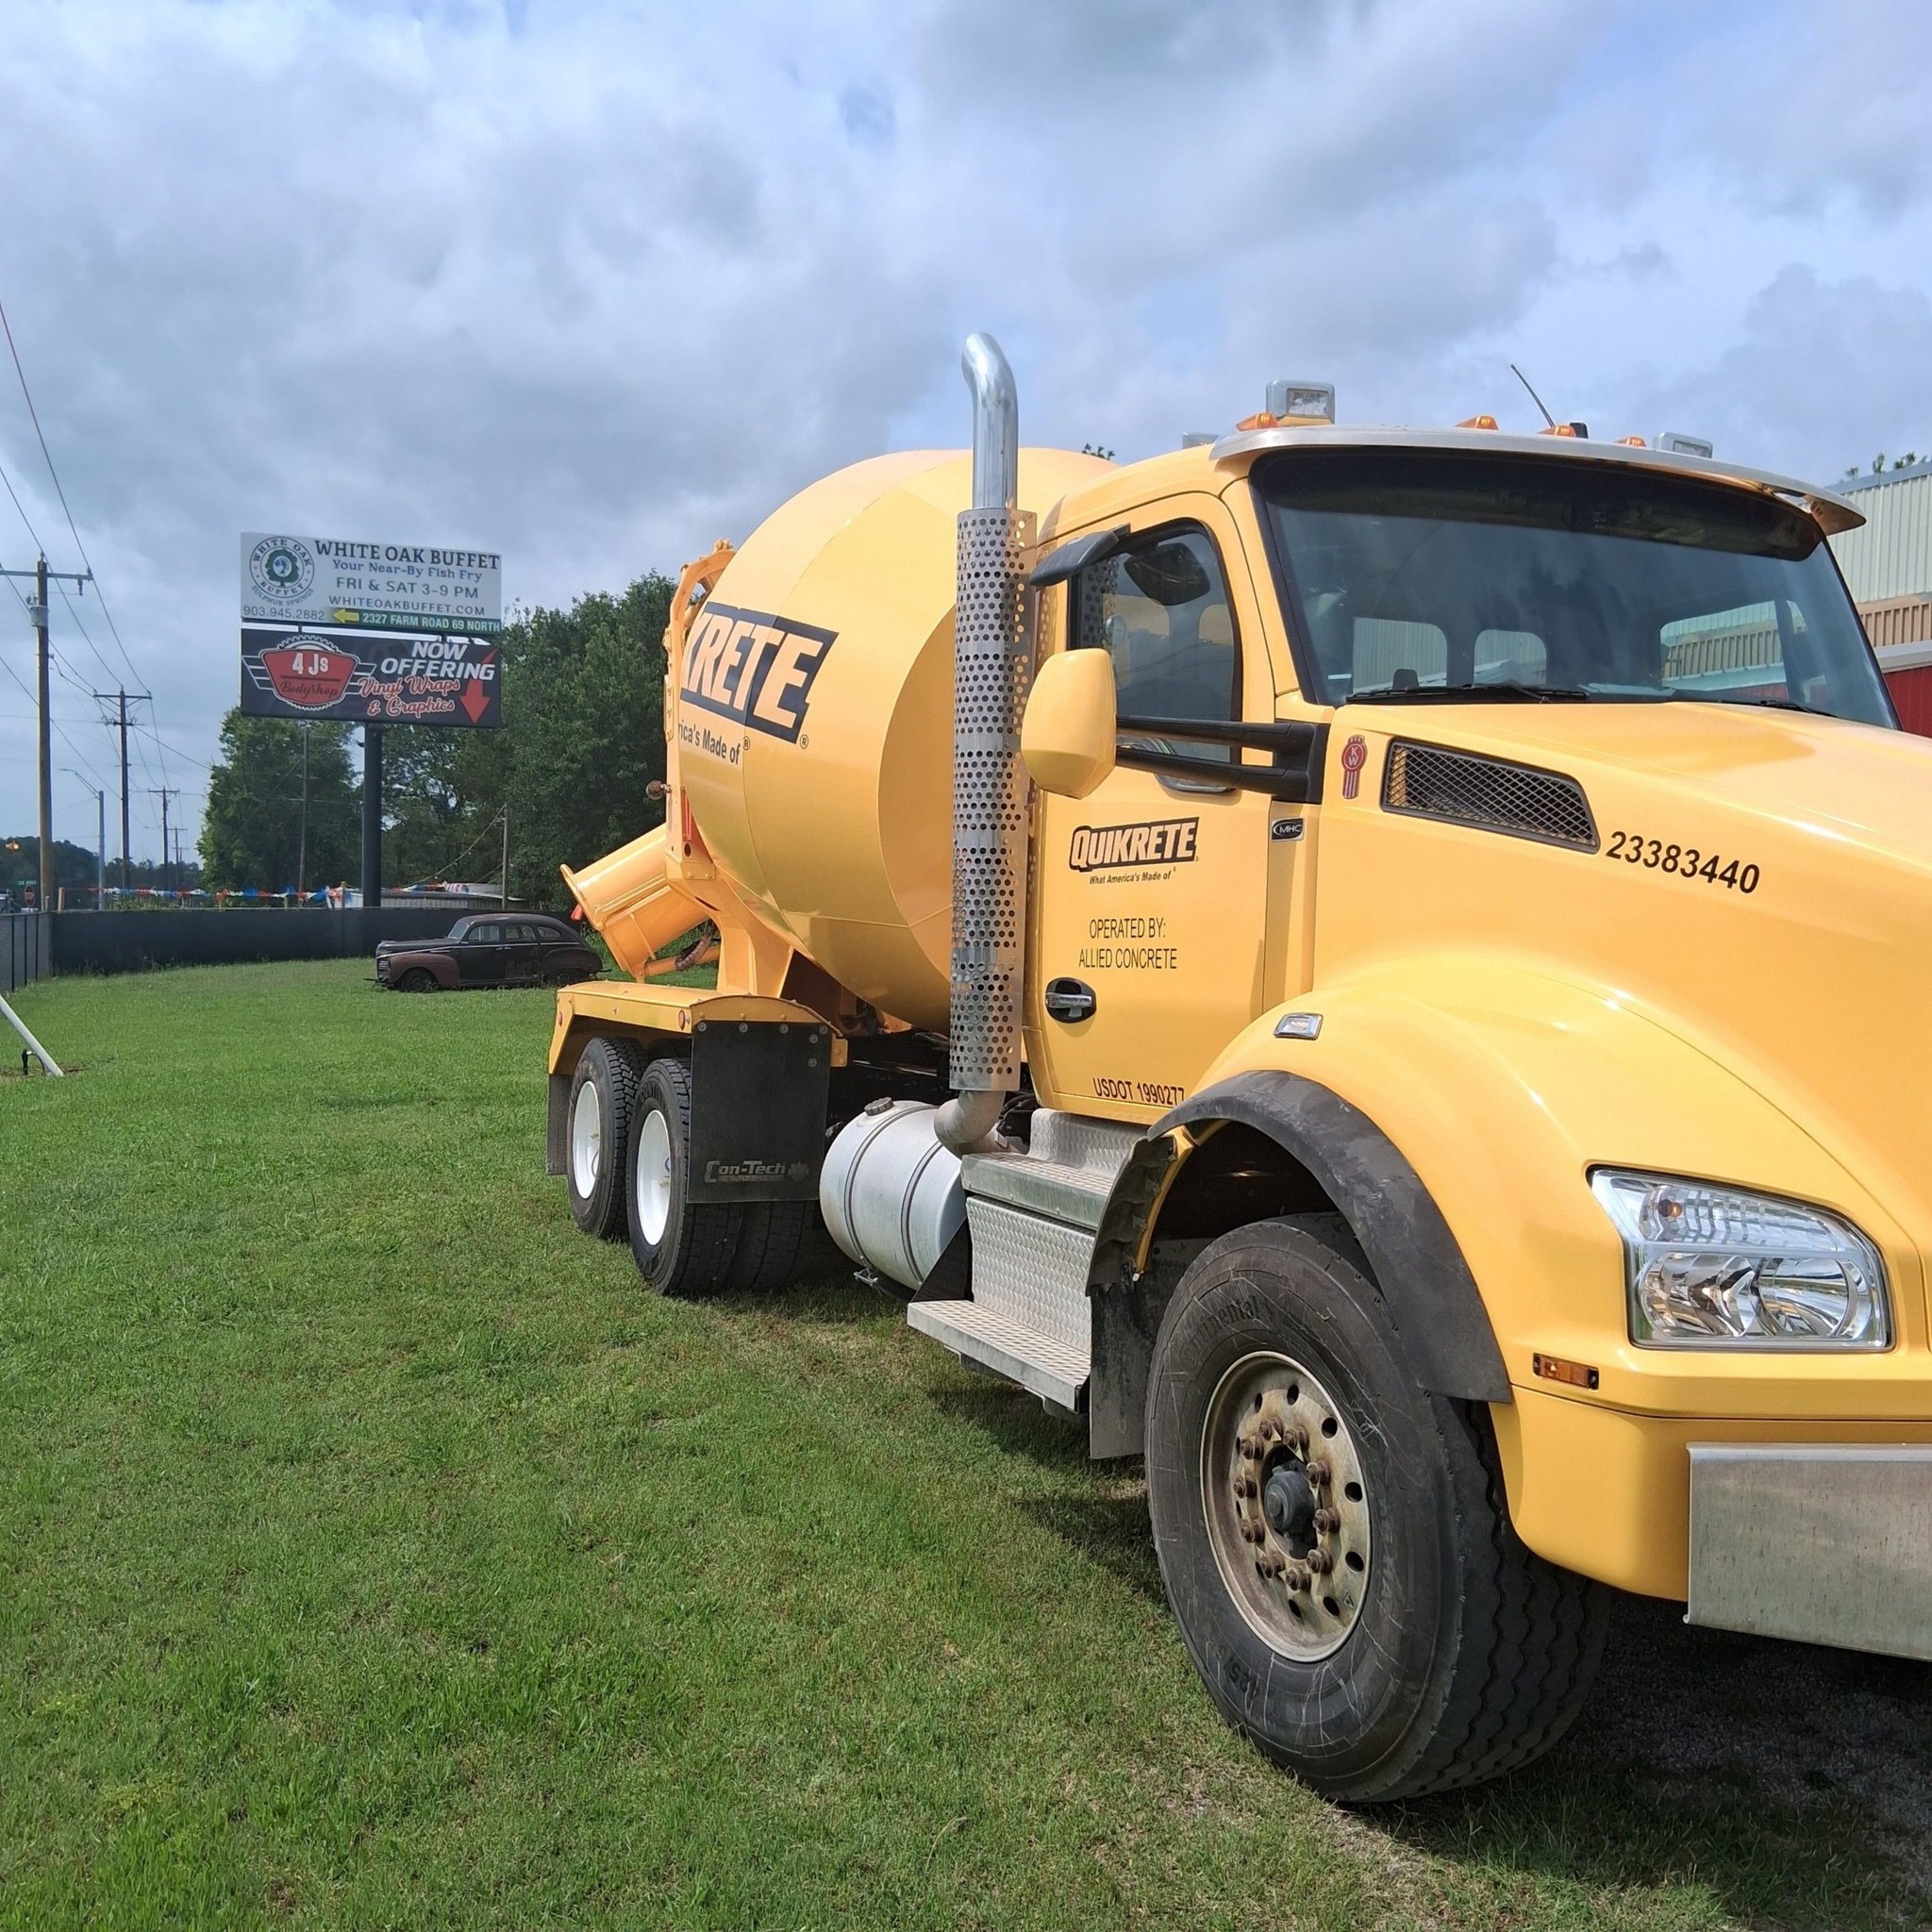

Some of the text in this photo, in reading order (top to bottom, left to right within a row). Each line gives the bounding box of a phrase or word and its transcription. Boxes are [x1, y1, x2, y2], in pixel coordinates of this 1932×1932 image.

[253, 539, 312, 566] WHITE OAK
[314, 540, 501, 570] WHITE OAK BUFFET
[332, 558, 483, 583] Your Near-By Fish Fry
[251, 585, 284, 607] SULPHUR
[259, 581, 305, 596] BUFFET
[336, 576, 362, 590] FRI
[368, 578, 380, 591] &
[386, 580, 417, 593] SAT
[454, 586, 478, 599] PM
[328, 595, 485, 616] WHITEOAKBUFFET.COM
[362, 612, 501, 633] 2327 FARM ROAD 69 NORTH
[411, 641, 469, 660] NOW
[292, 652, 329, 675] 4 Js
[380, 658, 496, 681] OFFERING
[358, 675, 461, 699] Vinyl Wraps
[367, 696, 456, 719] & Graphics
[702, 728, 727, 758] Made
[729, 742, 741, 765] of
[1070, 819, 1197, 870] QUIKRETE
[1605, 830, 1760, 894] 23383440
[1090, 870, 1172, 885] What America's Made of
[1089, 917, 1166, 939] OPERATED BY:
[1078, 948, 1177, 969] ALLIED CONCRETE
[1092, 1077, 1185, 1106] USDOT 1990277
[704, 1159, 786, 1184] Con-Tech
